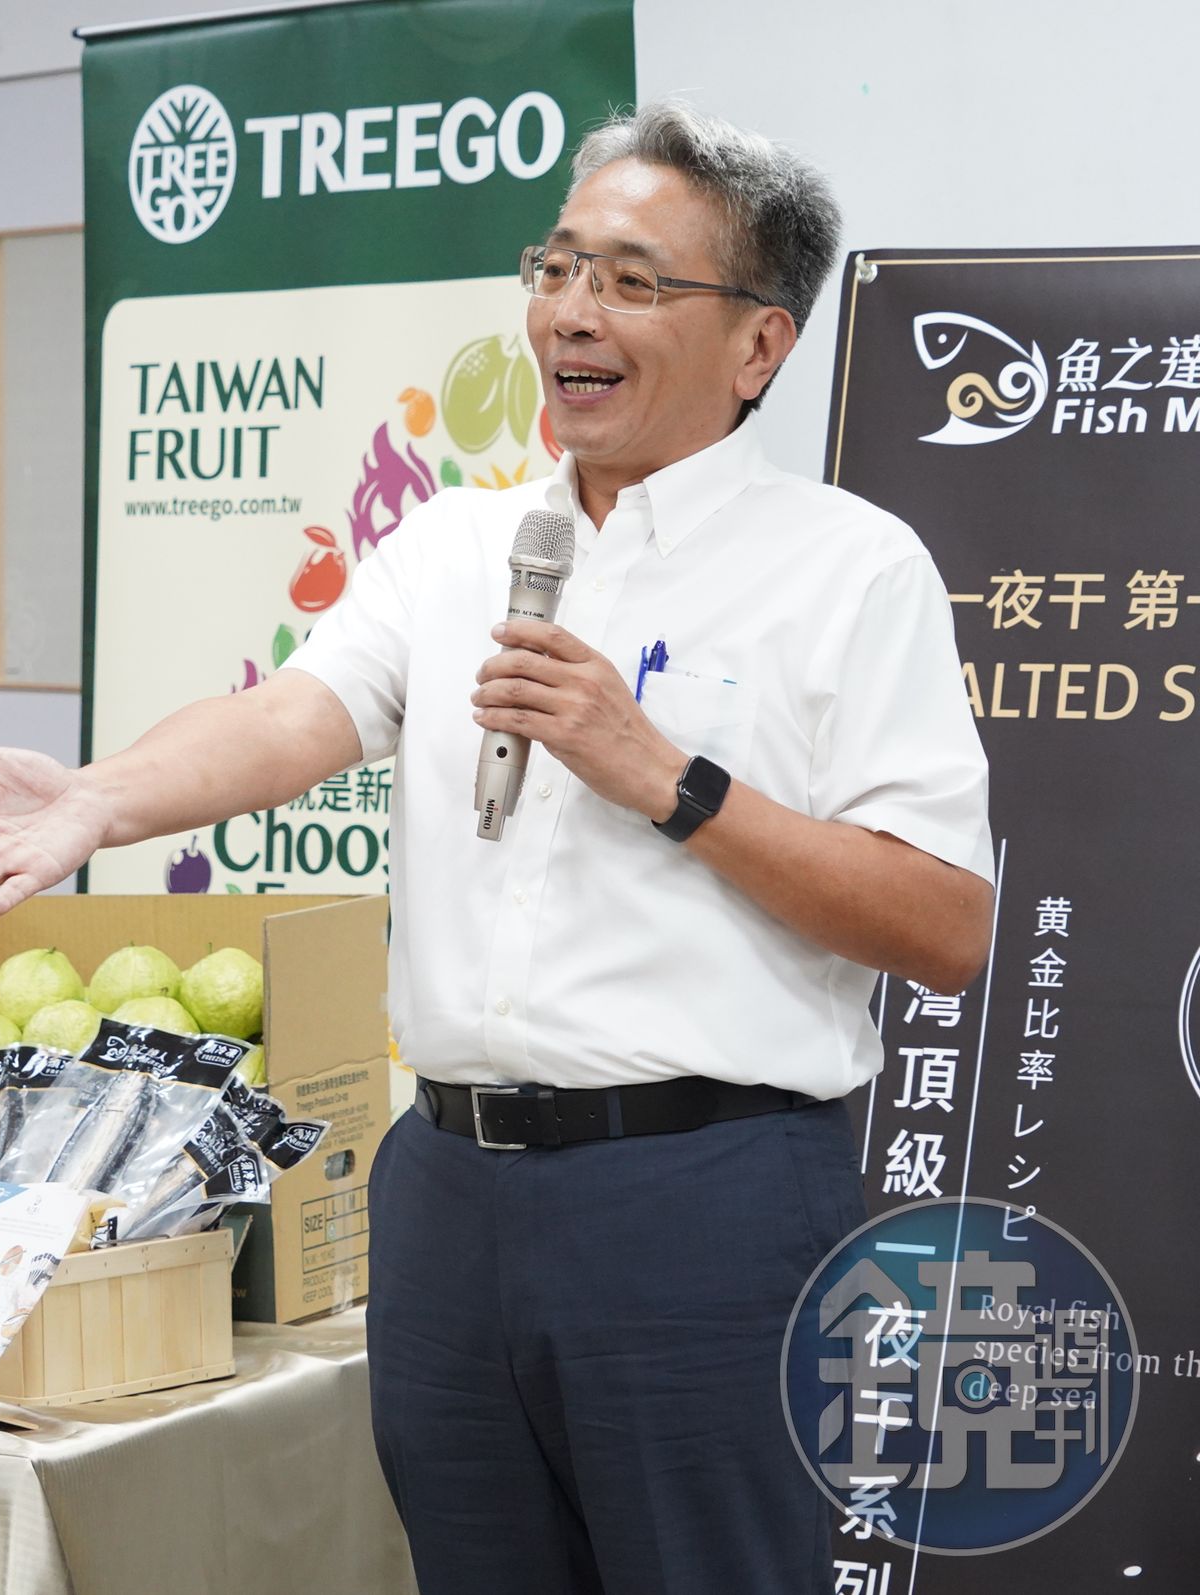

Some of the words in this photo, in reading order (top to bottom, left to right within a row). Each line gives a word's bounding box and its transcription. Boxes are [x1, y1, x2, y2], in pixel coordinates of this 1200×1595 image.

[245, 91, 565, 198] TREEGO
[129, 356, 325, 416] TAIWAN
[1051, 398, 1148, 434] Fish
[128, 425, 281, 482] FRUIT
[125, 495, 302, 522] www.treego.com.tw
[1123, 569, 1200, 631] 第
[213, 808, 390, 877] Choo
[304, 1213, 323, 1233] SIZE
[979, 1294, 1056, 1329] Royal
[1067, 1299, 1120, 1331] fish
[973, 1334, 1081, 1372] species
[1092, 1342, 1161, 1375] from
[968, 1372, 1039, 1410] deep
[1050, 1386, 1098, 1410] sea
